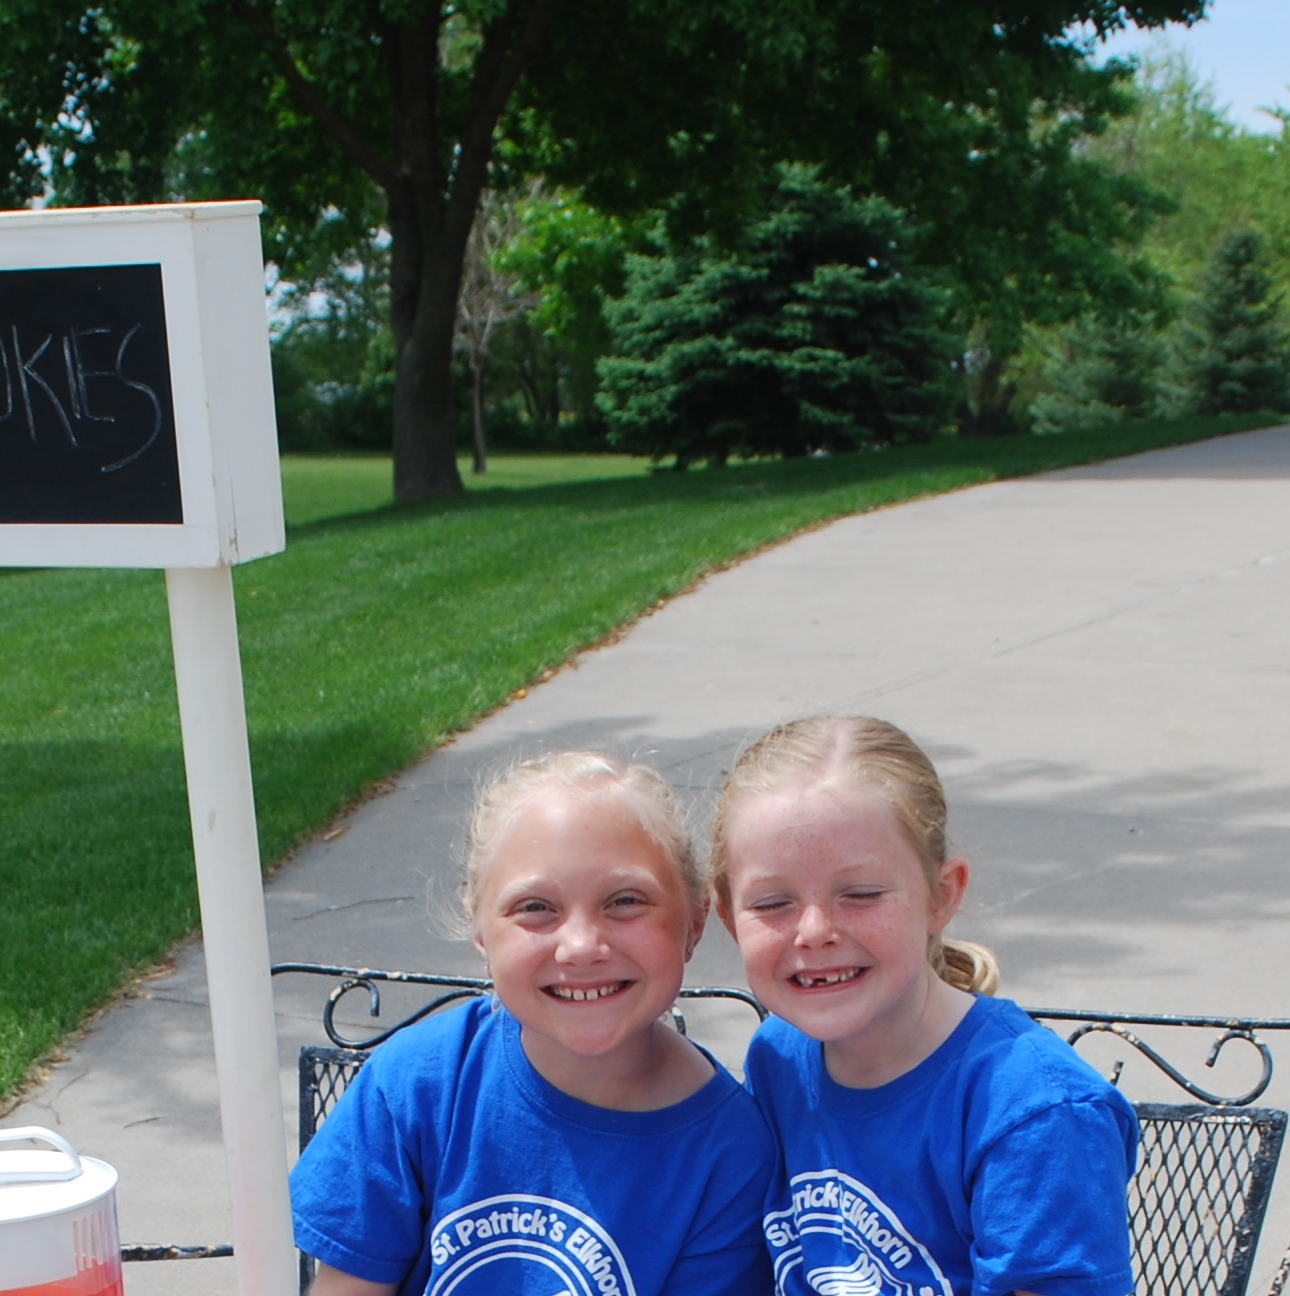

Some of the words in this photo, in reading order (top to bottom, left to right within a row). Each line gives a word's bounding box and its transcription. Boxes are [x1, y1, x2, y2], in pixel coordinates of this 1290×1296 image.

[431, 1234, 460, 1265] St.
[456, 1207, 565, 1246] Patrick's
[841, 1190, 913, 1269] Elkhorn
